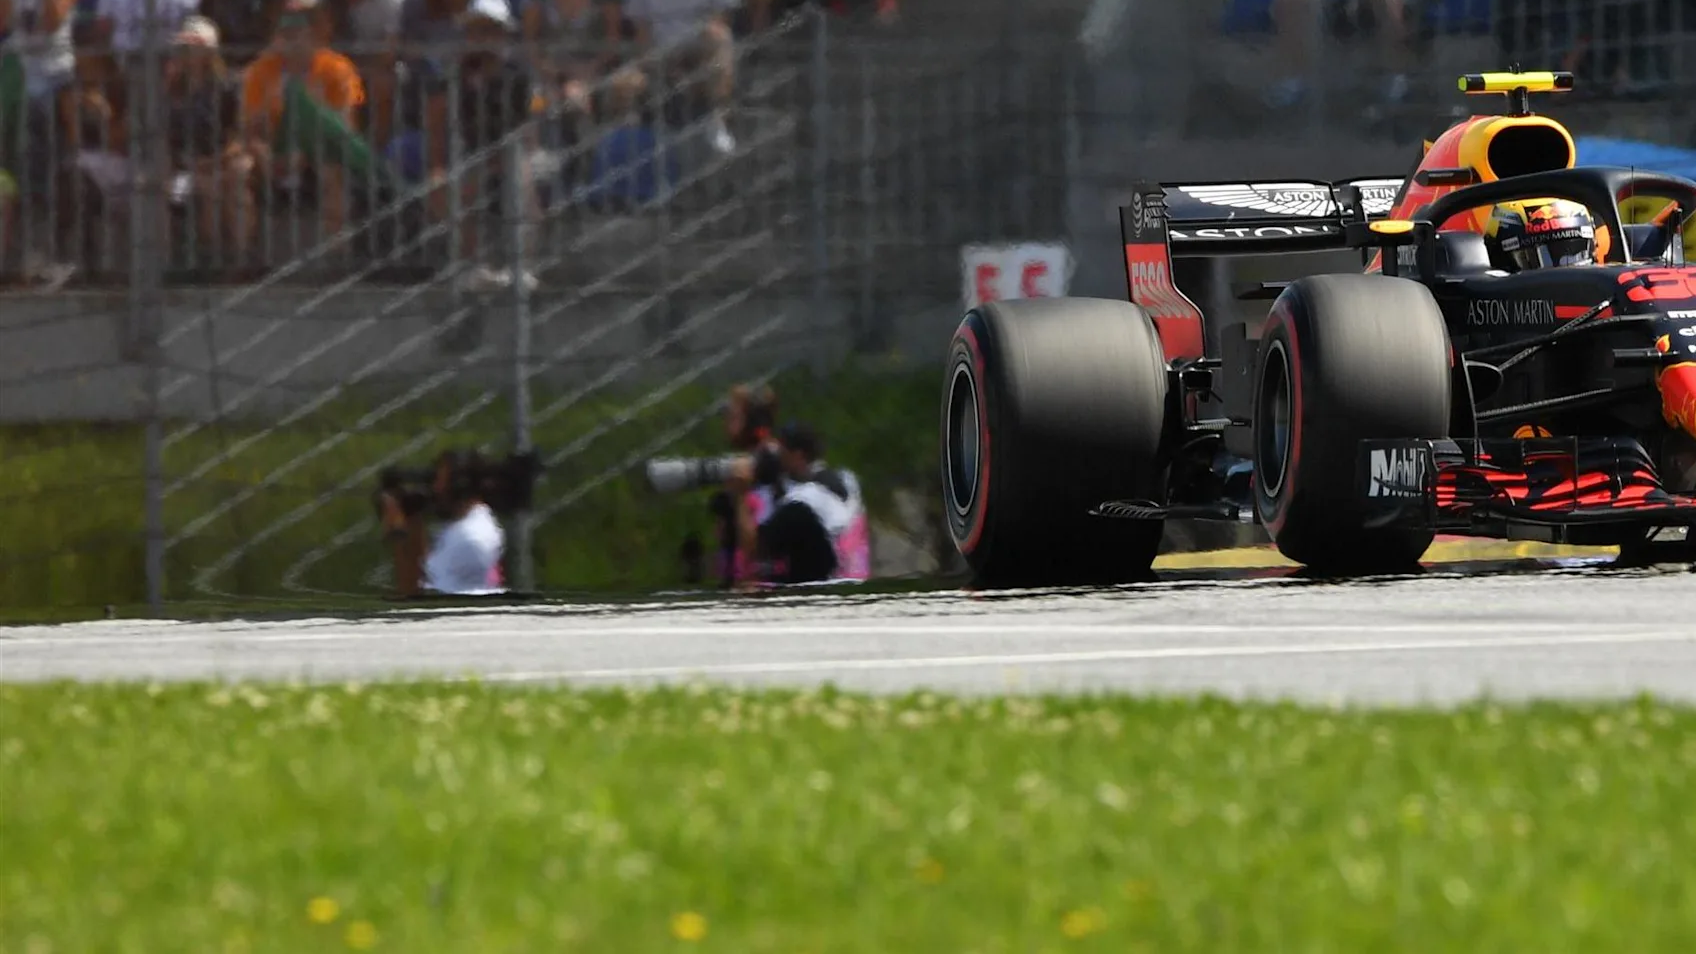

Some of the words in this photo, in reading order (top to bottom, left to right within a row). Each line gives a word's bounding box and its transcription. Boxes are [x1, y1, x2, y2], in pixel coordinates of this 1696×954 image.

[1273, 190, 1325, 202] ASTON
[1362, 188, 1396, 199] RTIN
[1467, 298, 1510, 326] ASTON
[1513, 298, 1554, 326] MARTIN
